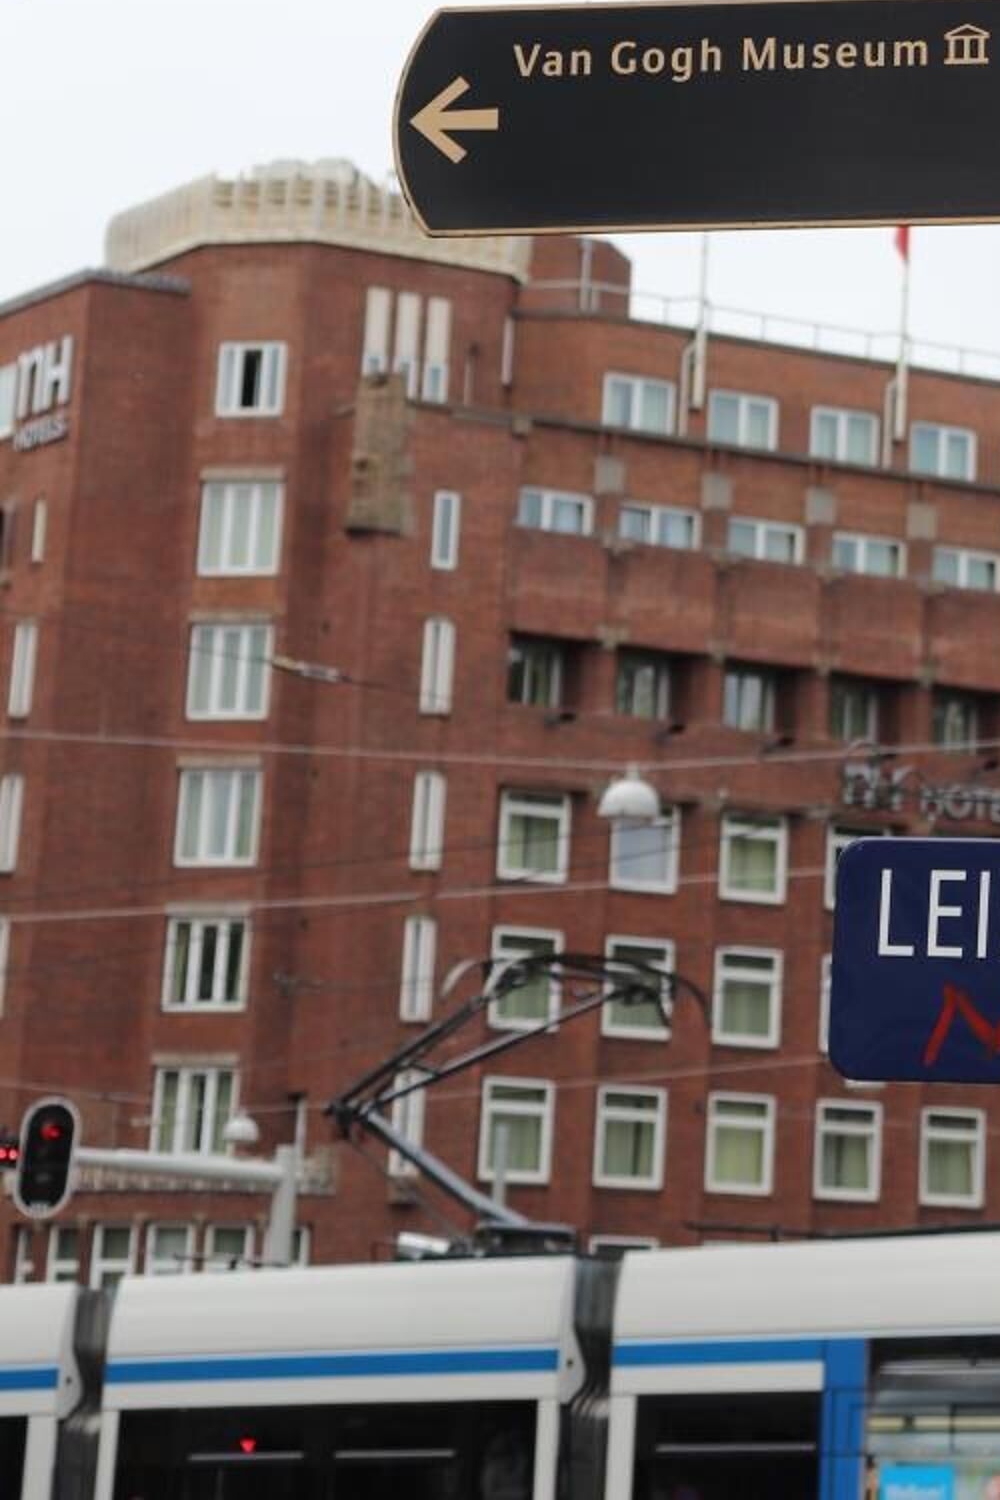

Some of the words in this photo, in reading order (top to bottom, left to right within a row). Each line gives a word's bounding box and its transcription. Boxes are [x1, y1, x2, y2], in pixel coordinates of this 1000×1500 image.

[513, 43, 592, 77] Van
[611, 37, 722, 82] Gogh
[742, 36, 928, 71] Museum
